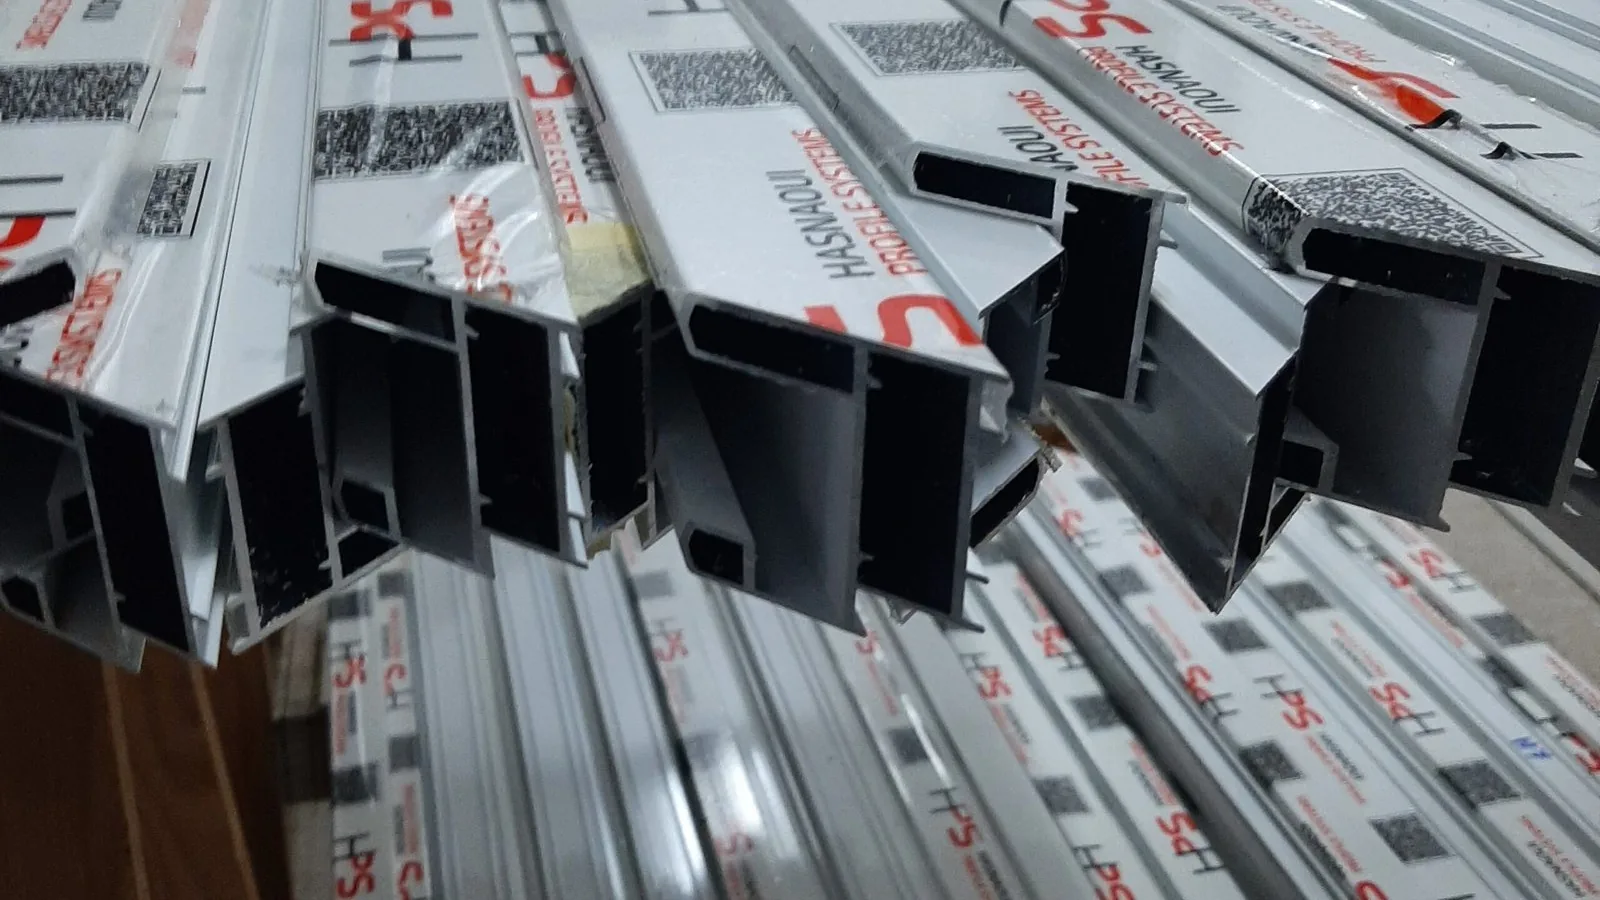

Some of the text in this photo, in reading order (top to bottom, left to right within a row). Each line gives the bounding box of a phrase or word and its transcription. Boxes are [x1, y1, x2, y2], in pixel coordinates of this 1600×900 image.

[1114, 45, 1242, 113] HASNAOUI
[1008, 89, 1102, 149] SYSTEMS
[766, 169, 876, 279] HASNAOUI
[791, 127, 930, 276] PROFILE SYSTEMS
[1252, 672, 1324, 731] HPS
[1368, 682, 1447, 738] HPS
